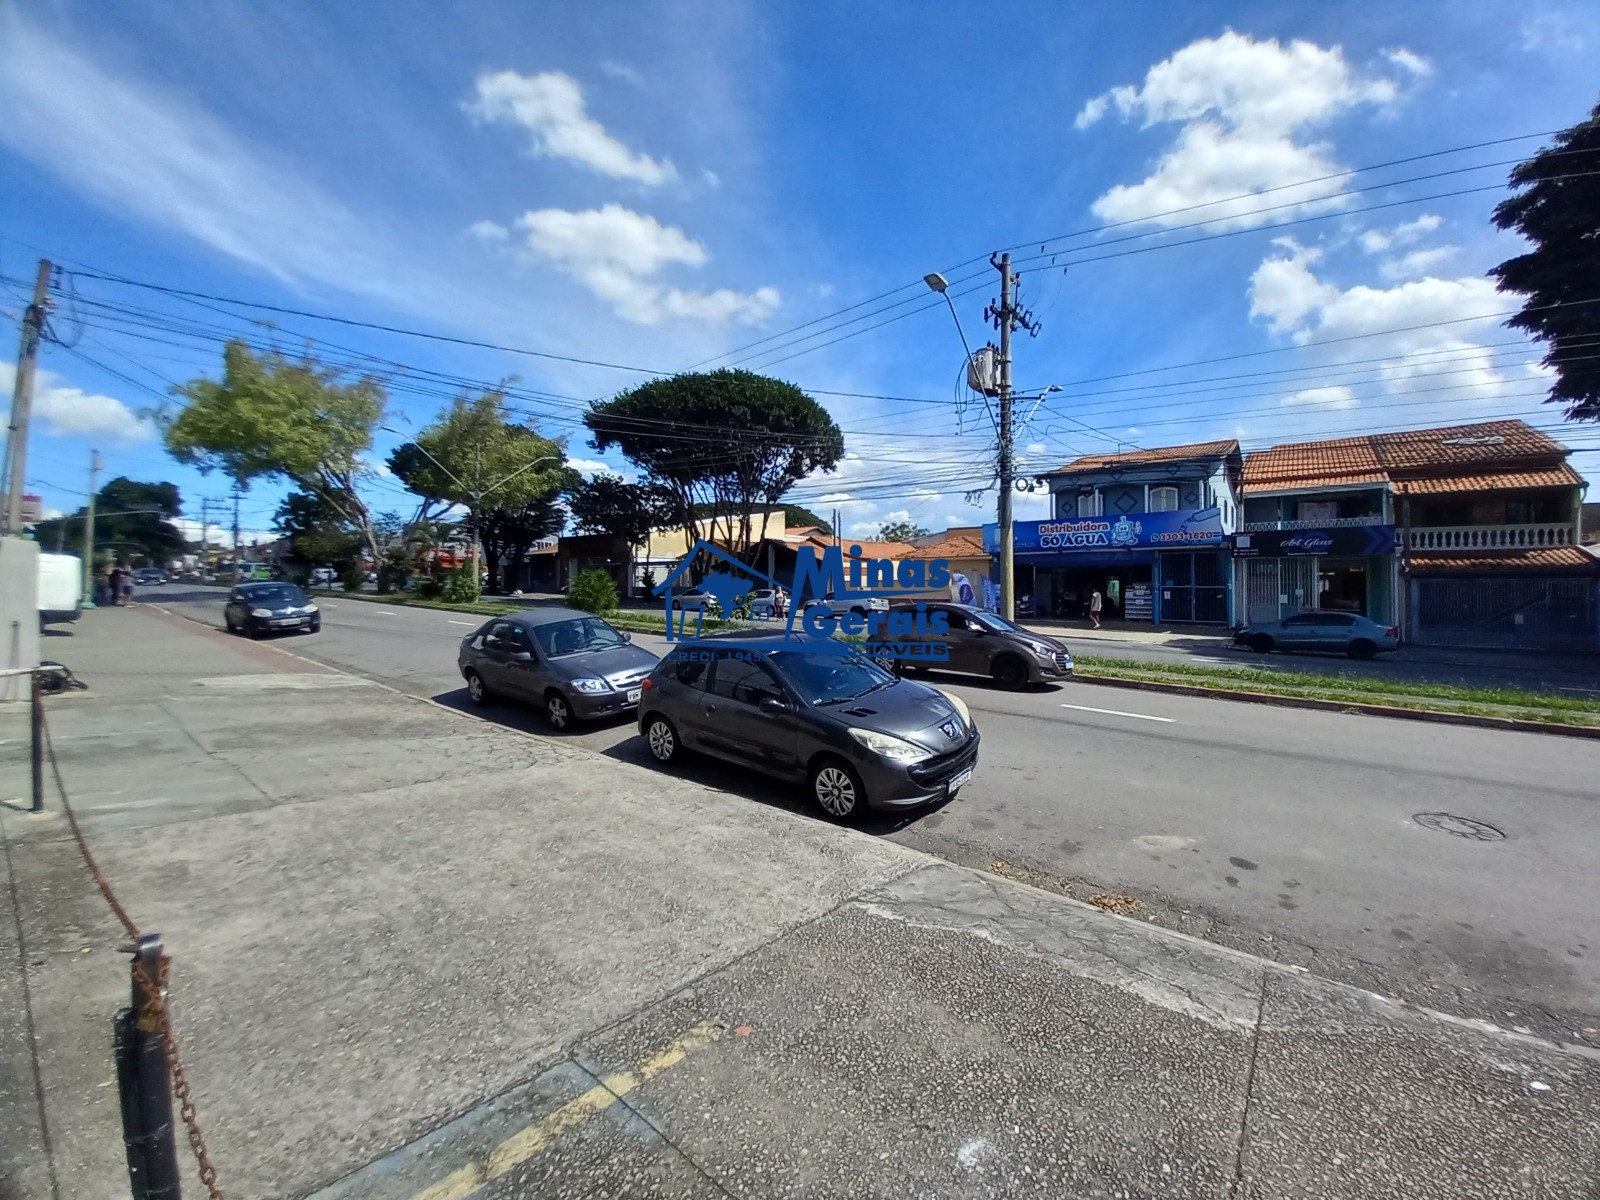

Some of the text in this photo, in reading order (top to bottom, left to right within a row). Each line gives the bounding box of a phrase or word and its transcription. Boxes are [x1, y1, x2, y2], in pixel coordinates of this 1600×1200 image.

[1039, 521, 1110, 534] Distribuidora
[1041, 534, 1060, 547] SÓ
[1062, 532, 1108, 546] ÁGUA
[1160, 531, 1214, 541] 3303-1620
